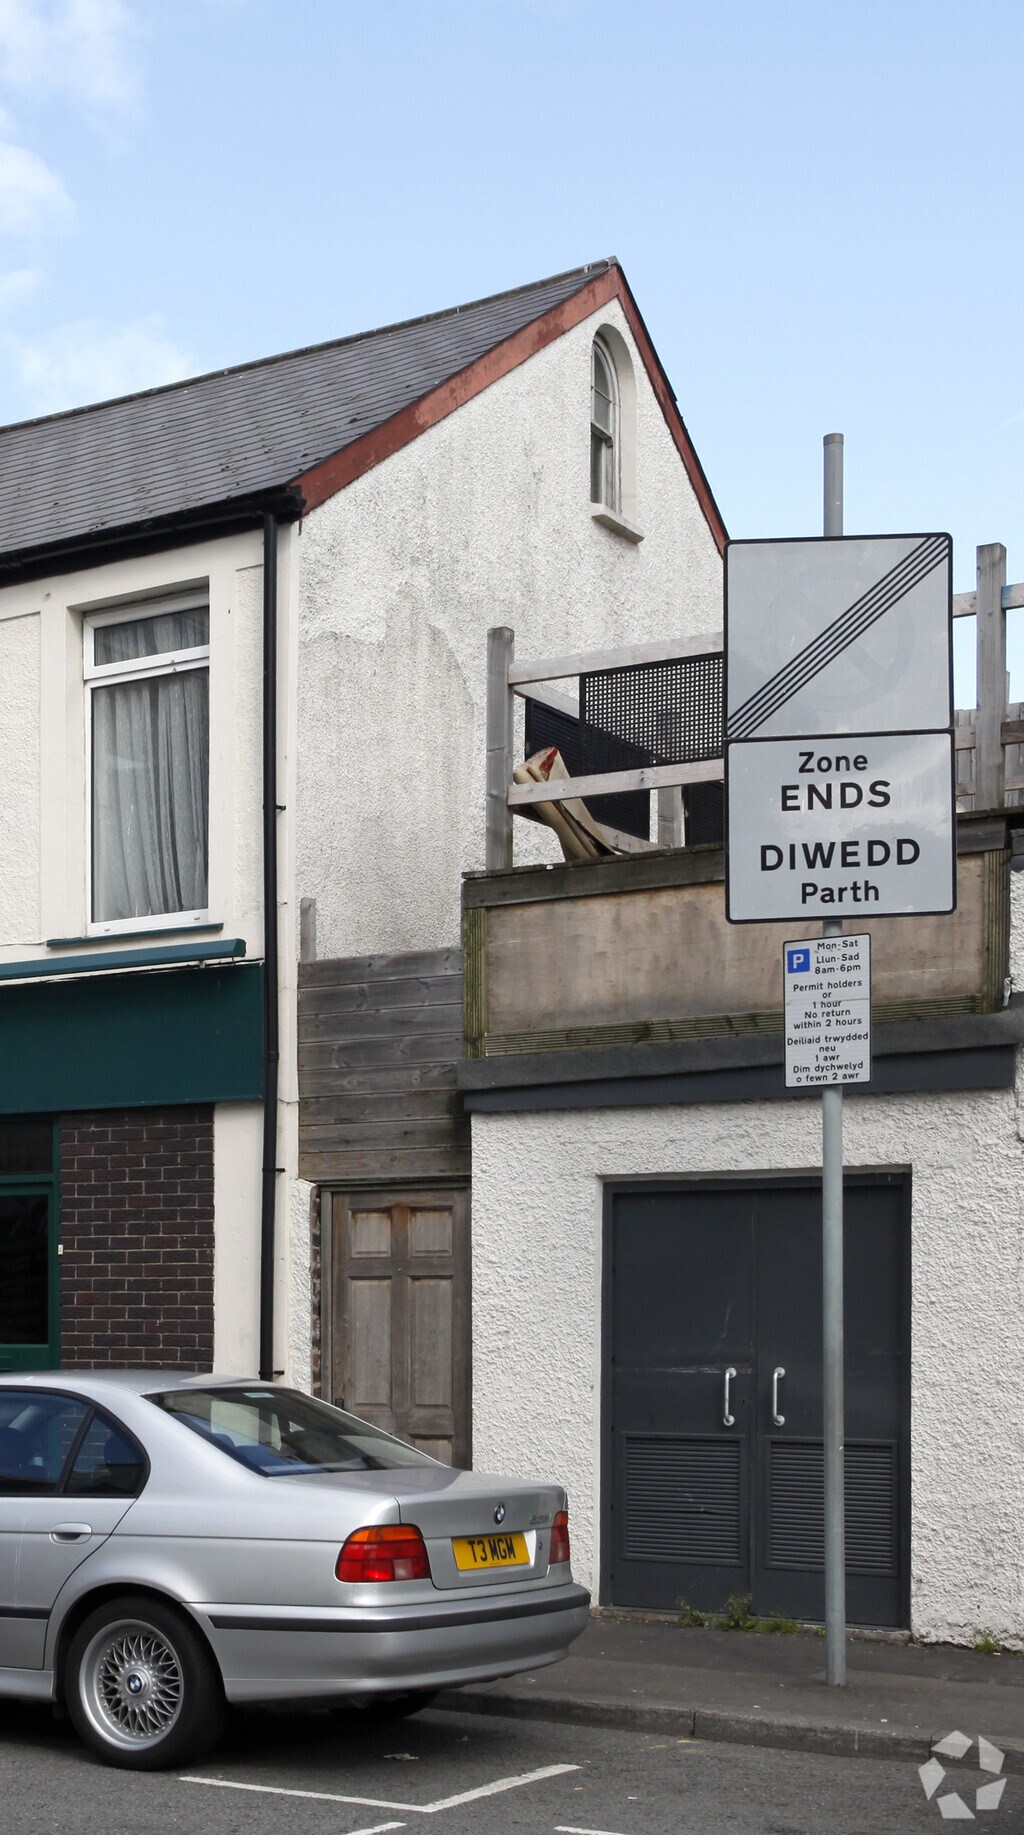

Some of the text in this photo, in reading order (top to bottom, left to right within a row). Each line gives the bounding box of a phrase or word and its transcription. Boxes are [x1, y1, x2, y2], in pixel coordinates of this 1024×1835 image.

[798, 751, 868, 774] Zone
[781, 780, 892, 812] ENDS
[760, 838, 920, 872] DIWEDD
[801, 881, 880, 904] Parth
[817, 939, 859, 951] Mon-Sat
[792, 953, 805, 970] P
[816, 952, 860, 964] Llun-Sad
[814, 964, 861, 975] 8am-6pm
[793, 980, 863, 992] Permit holders
[820, 1000, 842, 1009] hour
[804, 1009, 851, 1019] No return
[793, 1018, 862, 1030] within 2 hours
[787, 1032, 869, 1046] Deiliaid trwydded
[823, 1054, 840, 1062] awr
[793, 1061, 864, 1074] Dim dychwelyd
[806, 1074, 828, 1082] fewn
[832, 1072, 838, 1080] 2
[842, 1072, 860, 1080] awr
[467, 1536, 517, 1563] T3 MGM
